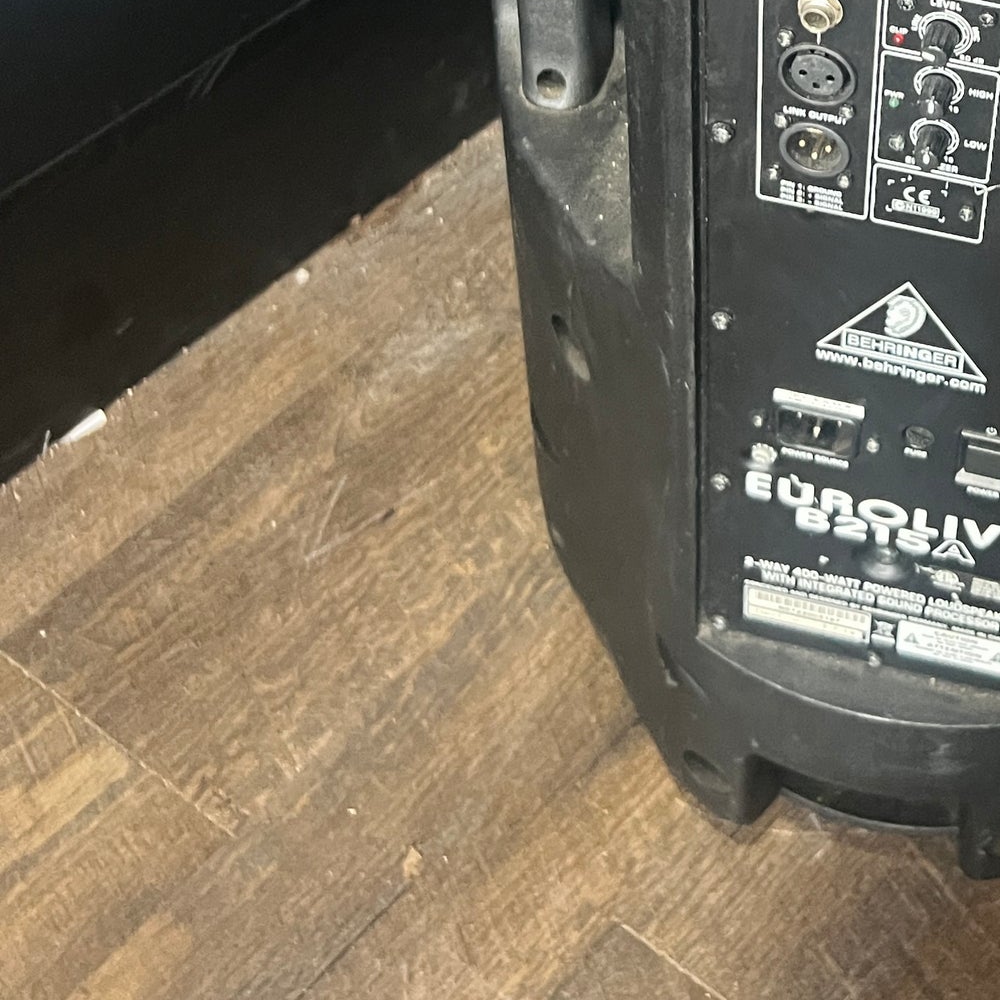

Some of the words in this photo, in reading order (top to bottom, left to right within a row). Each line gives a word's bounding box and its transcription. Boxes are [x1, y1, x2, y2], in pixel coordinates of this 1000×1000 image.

[968, 87, 994, 100] HIGH
[783, 105, 806, 118] LINK
[808, 110, 847, 126] OUTPUT
[963, 139, 988, 151] LOW
[846, 332, 958, 369] BEHRINGER
[815, 348, 987, 395] www.behringer.com
[761, 568, 796, 589] WITH
[796, 577, 876, 606] INTEGRATED
[876, 594, 924, 617] SOUND
[924, 605, 1000, 634] PROCESSOR
[792, 566, 862, 589] 400-WATT
[862, 580, 927, 606] POWERED
